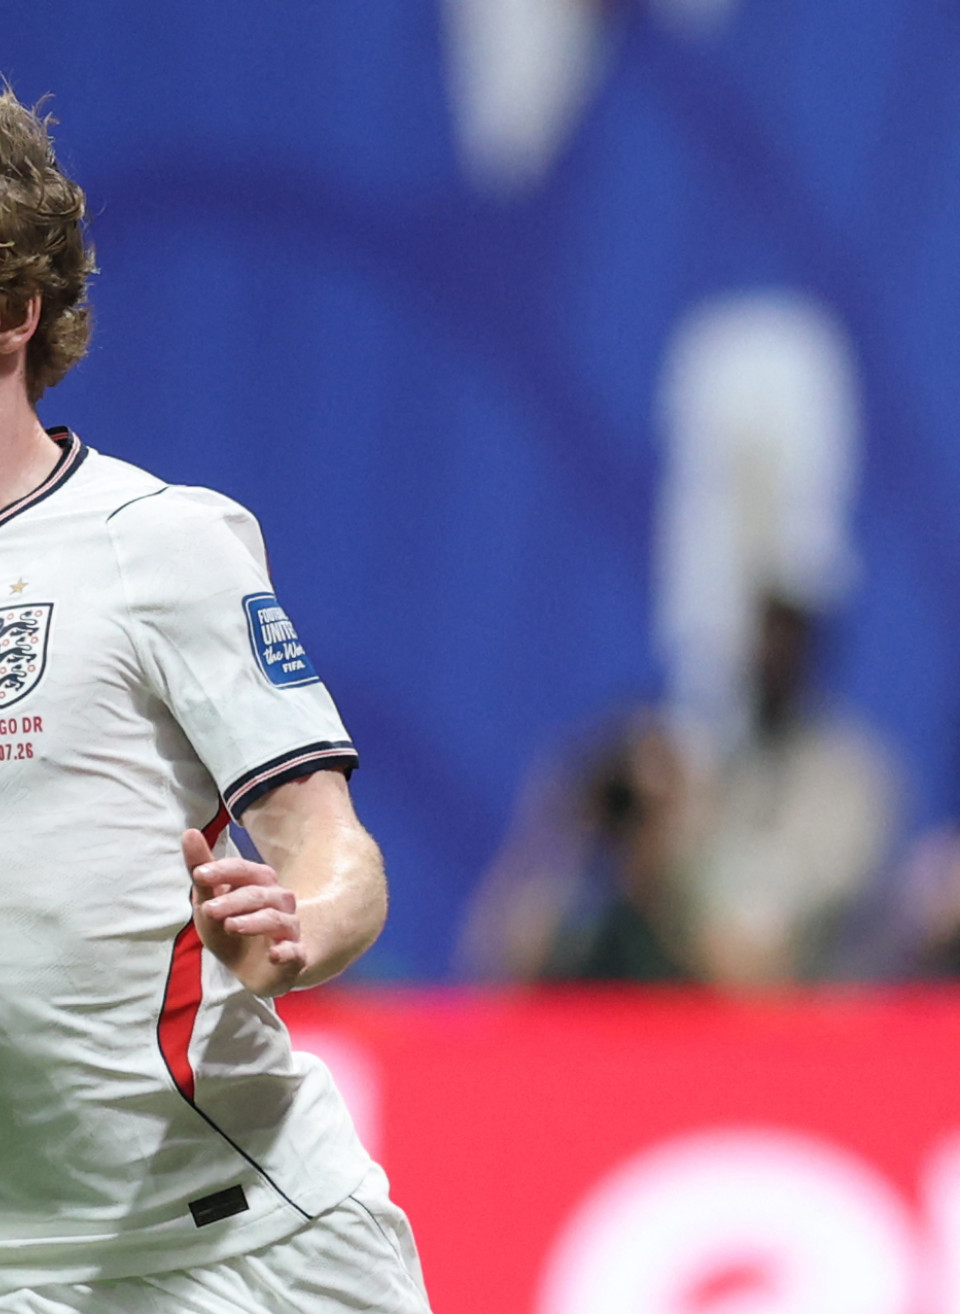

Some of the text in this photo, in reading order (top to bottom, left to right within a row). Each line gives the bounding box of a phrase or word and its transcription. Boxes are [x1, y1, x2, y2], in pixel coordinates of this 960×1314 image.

[263, 645, 283, 665] the
[282, 660, 306, 673] FIFA
[22, 715, 43, 734] DR
